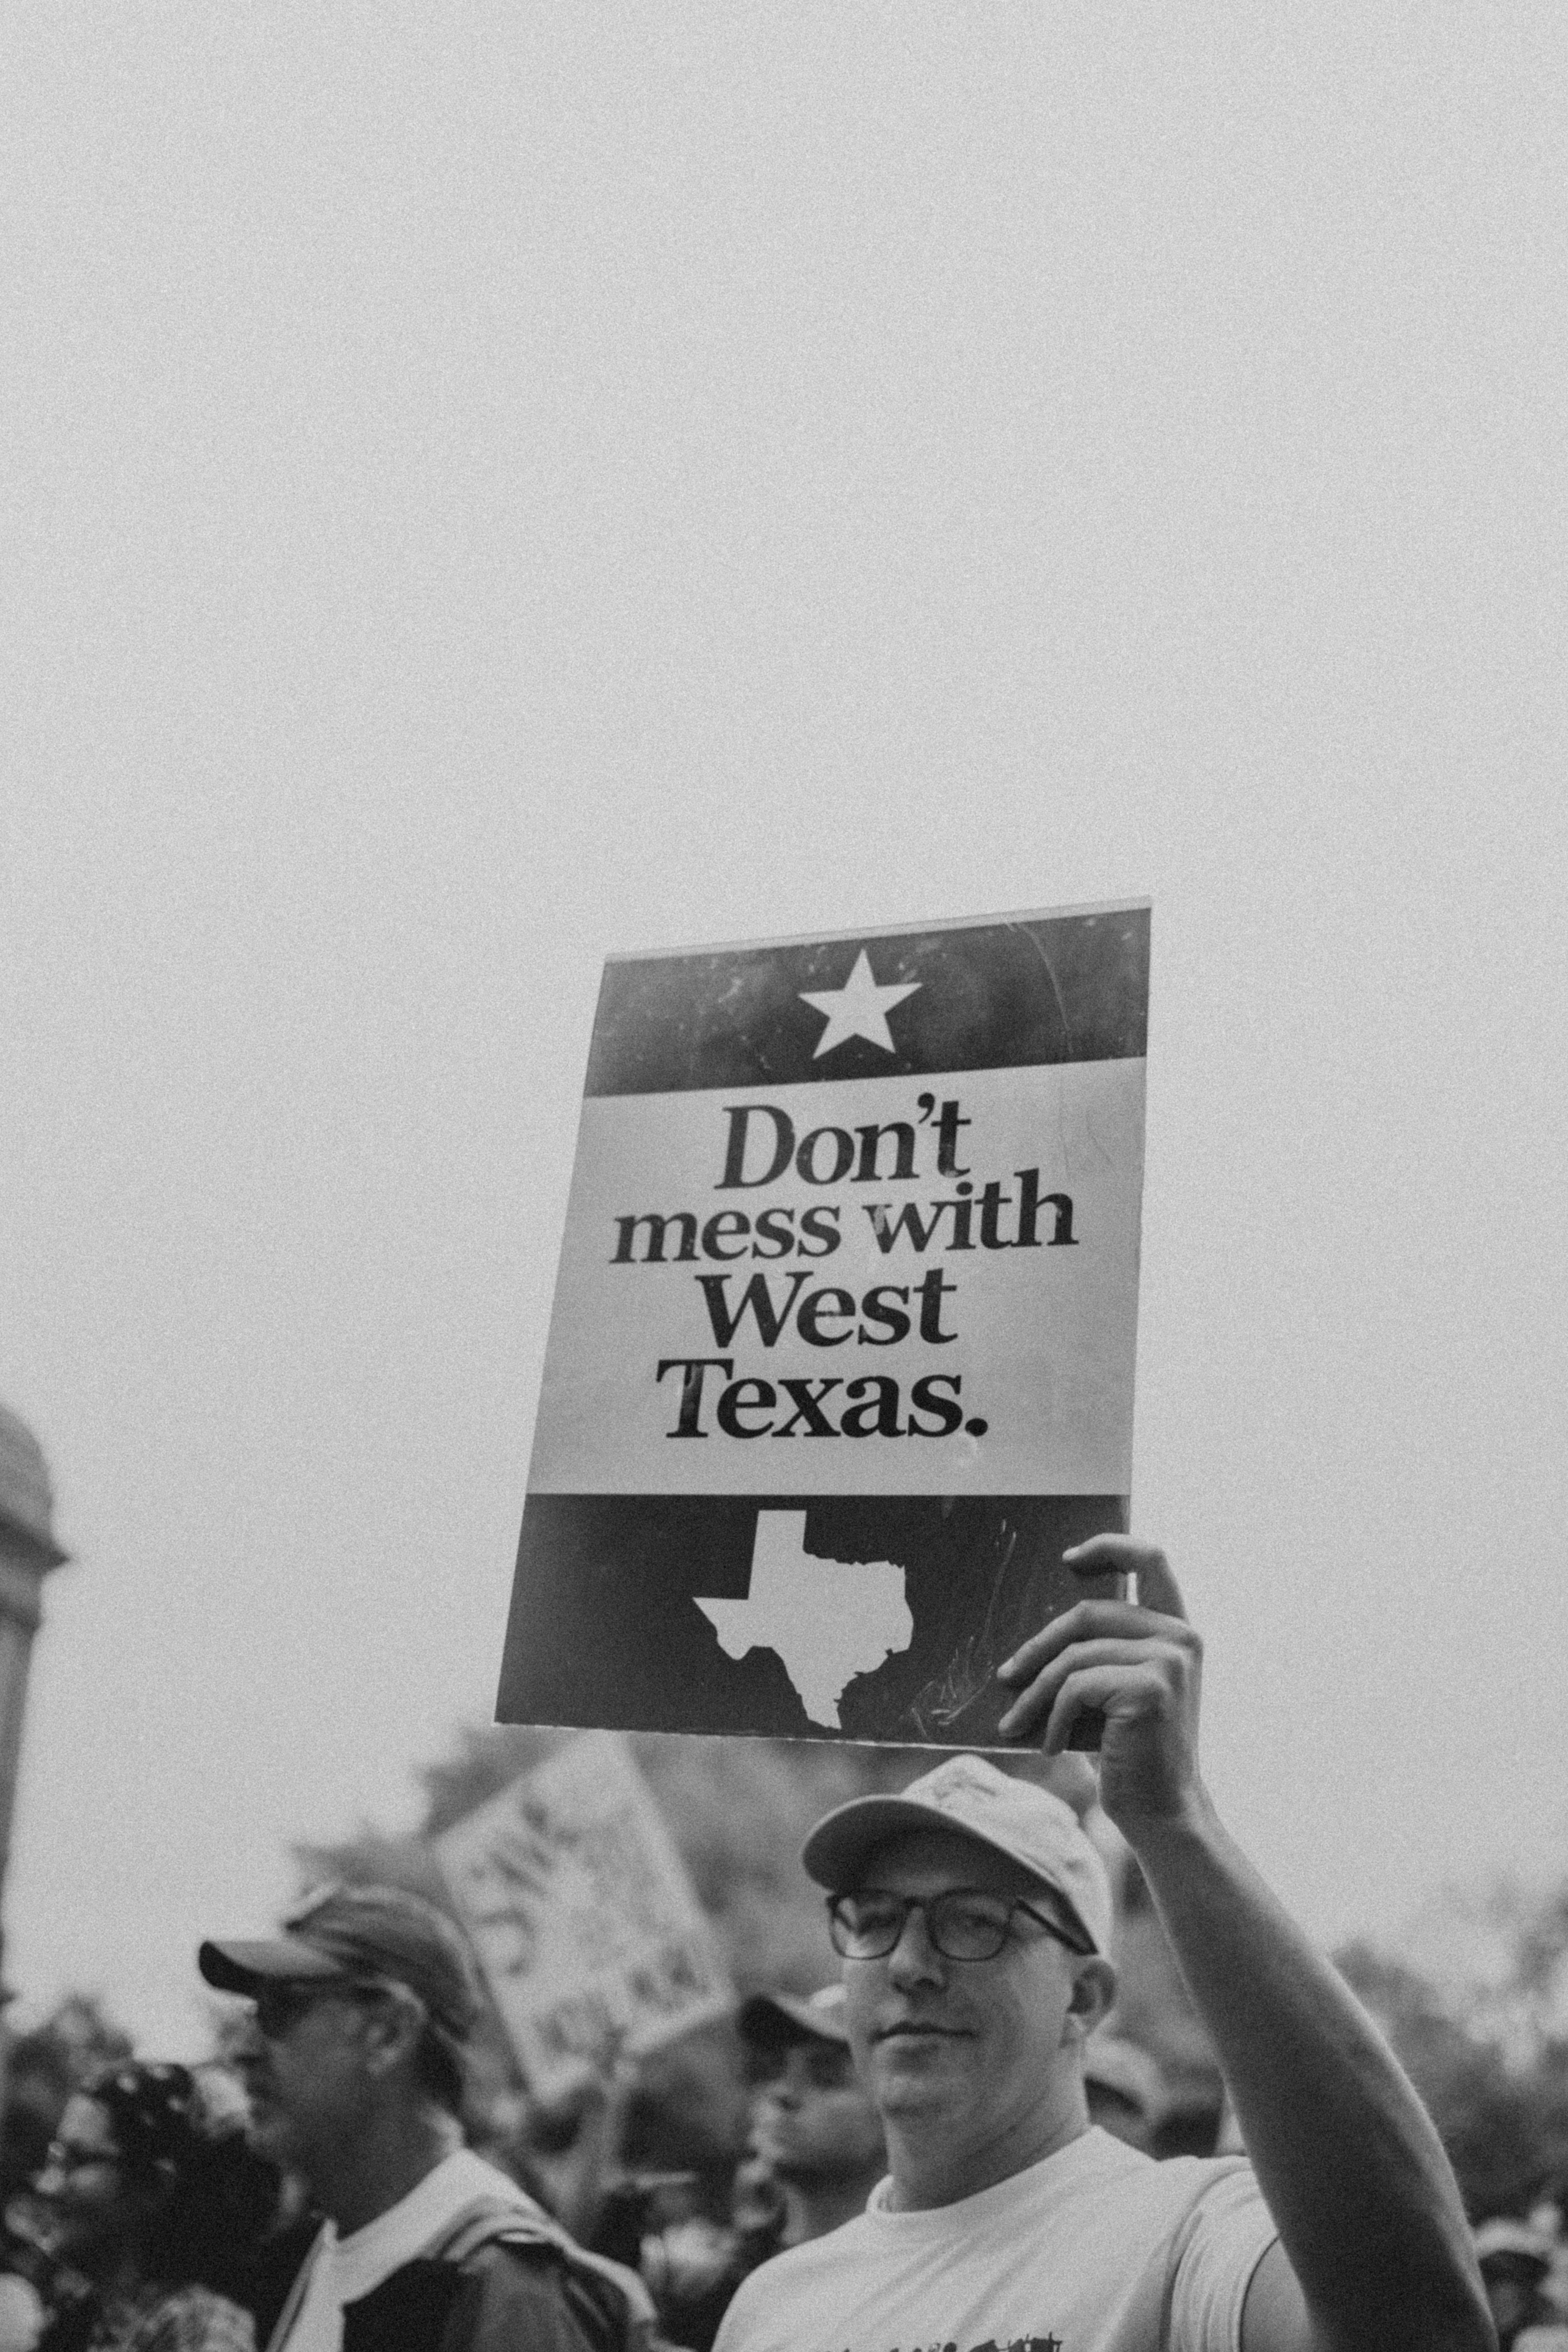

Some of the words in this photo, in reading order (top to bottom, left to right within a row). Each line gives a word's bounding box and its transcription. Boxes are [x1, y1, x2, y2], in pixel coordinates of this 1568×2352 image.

[715, 1093, 971, 1189] Don't
[610, 1207, 840, 1263] mess
[863, 1169, 1079, 1253] with
[695, 1269, 958, 1348] West
[656, 1358, 989, 1439] Texas.
